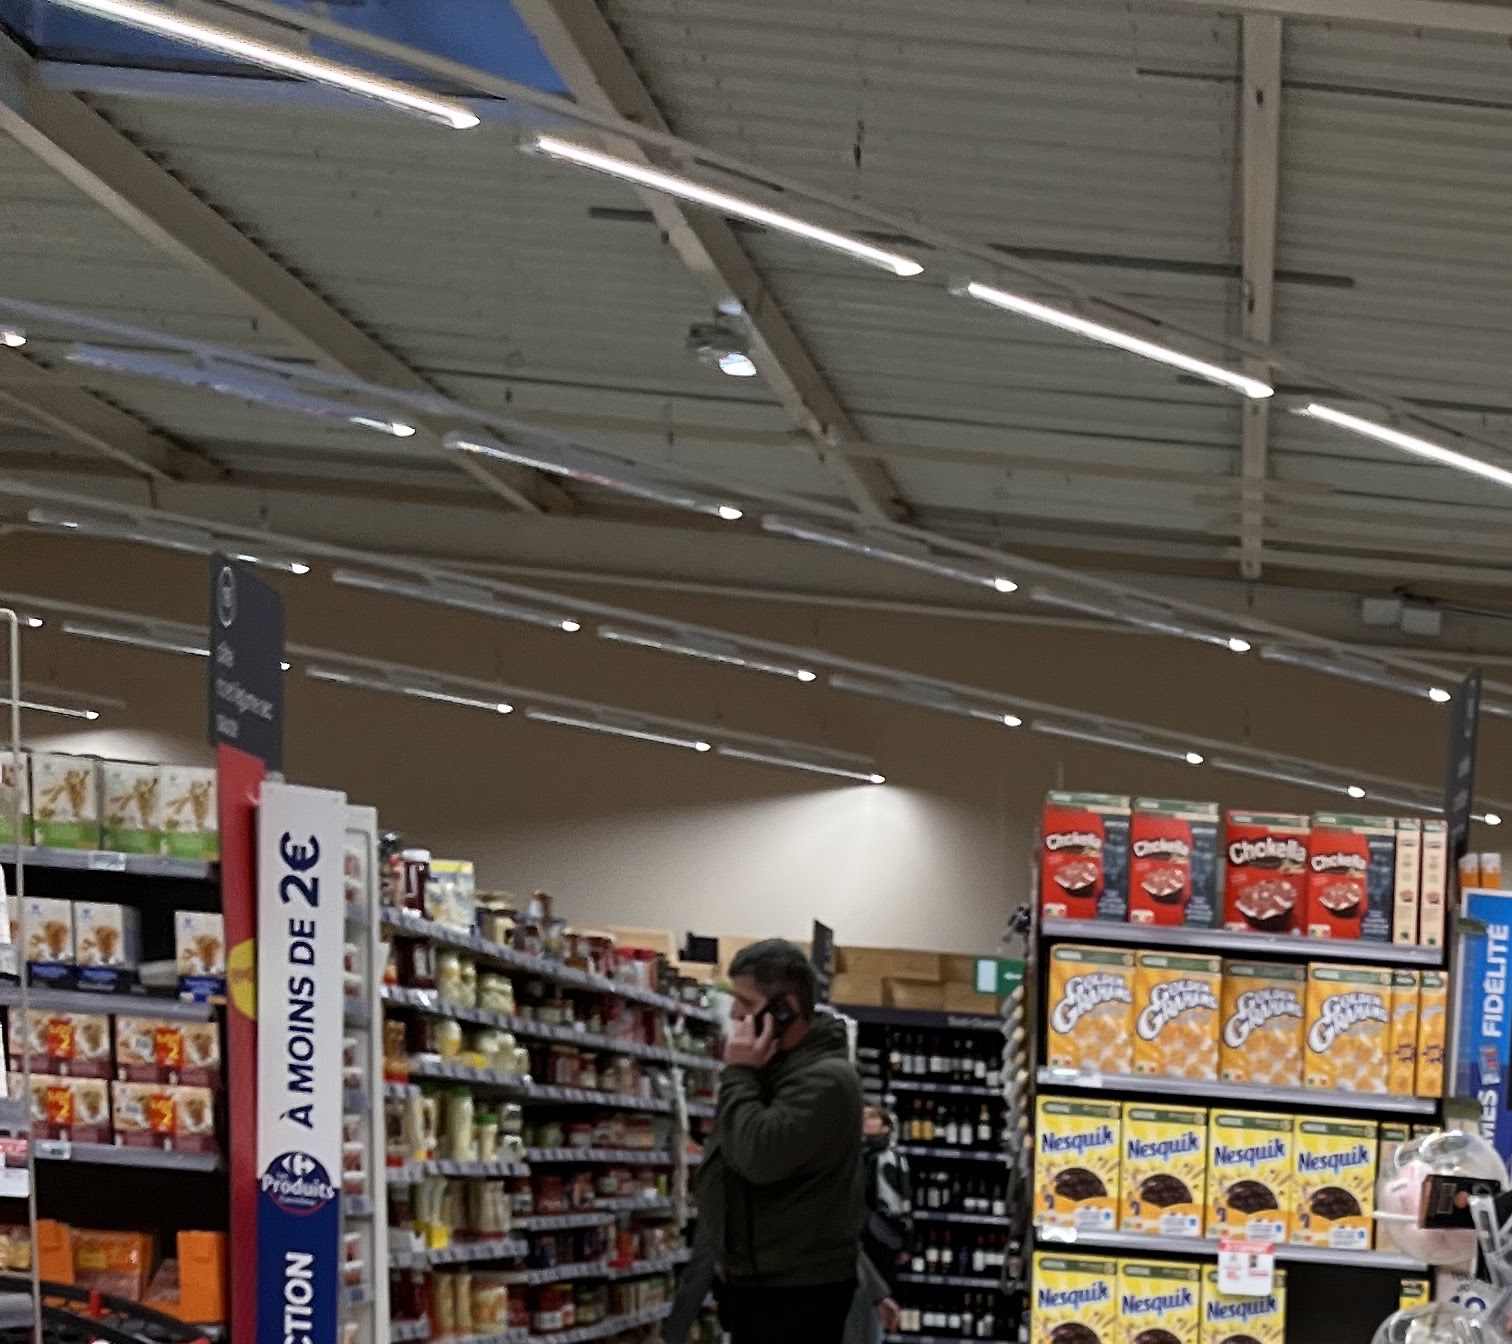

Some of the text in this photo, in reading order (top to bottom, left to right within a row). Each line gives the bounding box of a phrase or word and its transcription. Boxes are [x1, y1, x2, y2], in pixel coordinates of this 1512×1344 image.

[279, 831, 320, 1129] À MOINS DE 2€
[1041, 1125, 1114, 1155] Nesquik
[1127, 1131, 1199, 1162] Nesquik
[1214, 1138, 1286, 1168] Nesquik
[1298, 1144, 1369, 1175] Nesquik
[1038, 1280, 1109, 1311] Nesquik
[1122, 1287, 1193, 1317] Nesquik
[1206, 1293, 1277, 1323] Nesquik
